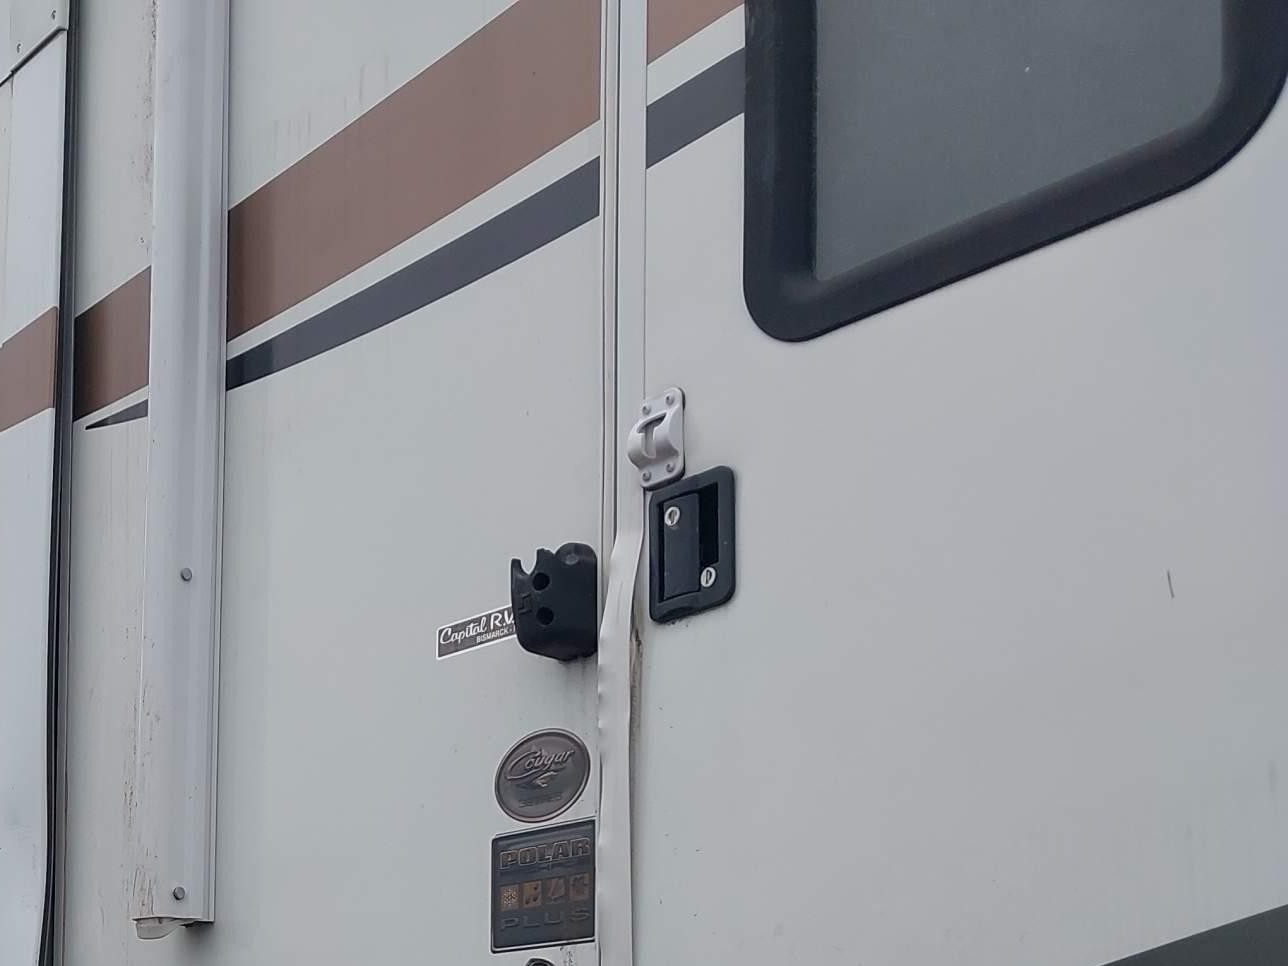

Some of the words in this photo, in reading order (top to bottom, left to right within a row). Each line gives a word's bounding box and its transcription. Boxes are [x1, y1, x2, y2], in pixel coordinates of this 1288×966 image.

[440, 616, 488, 644] Capital
[476, 627, 509, 643] BISMARCK
[505, 748, 575, 781] Cougar
[500, 838, 590, 869] POLAR
[500, 907, 591, 931] PLUS
